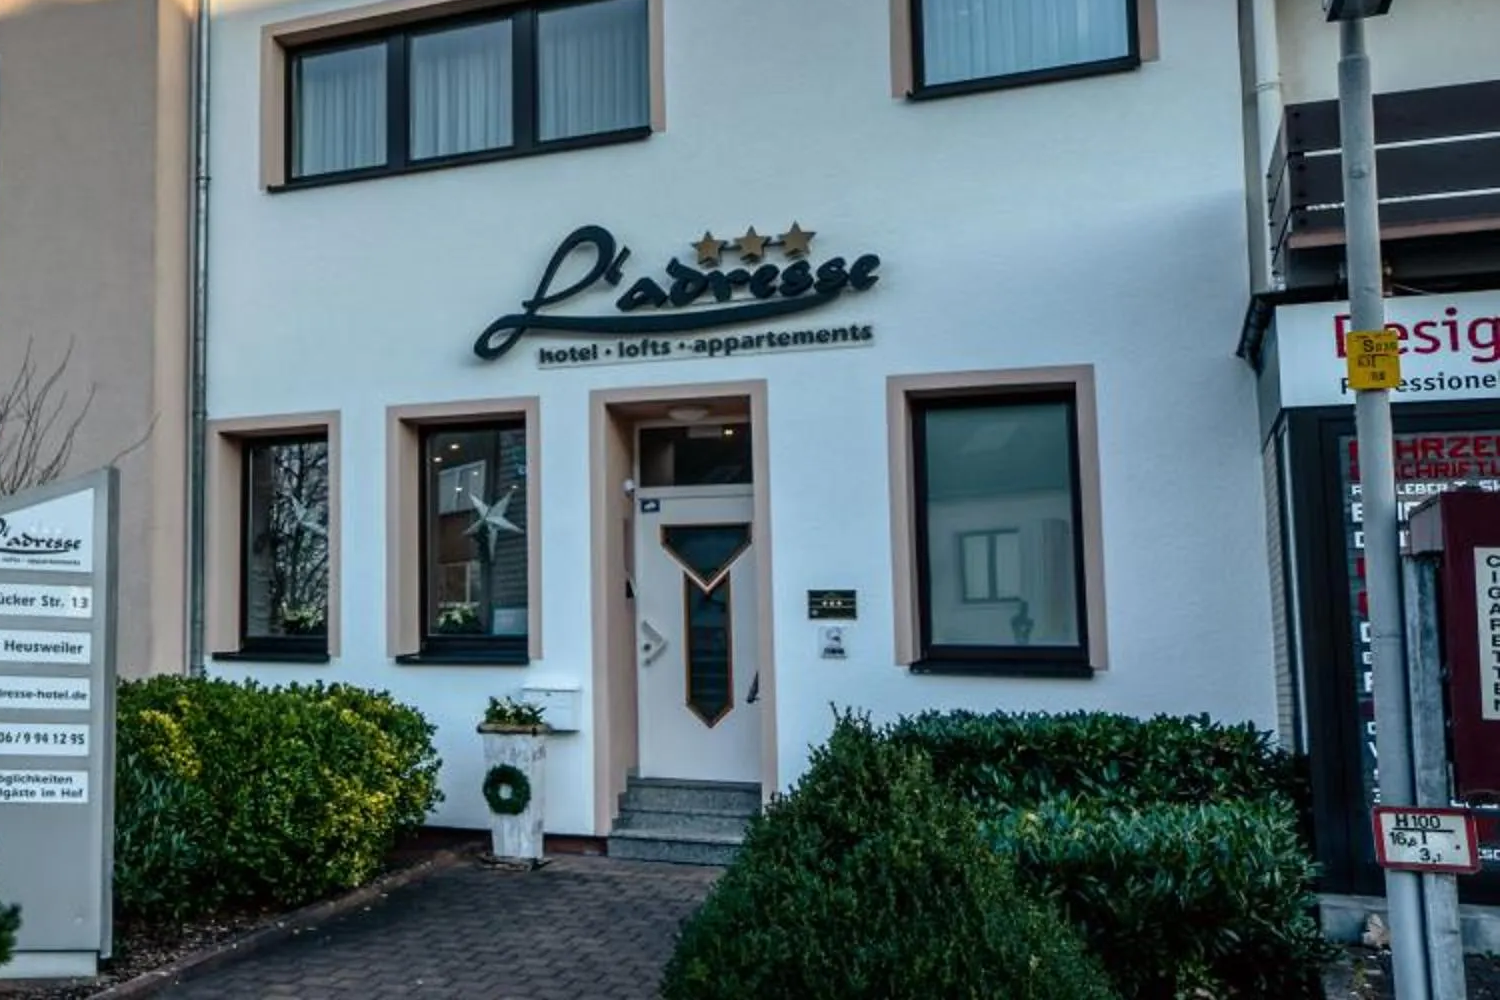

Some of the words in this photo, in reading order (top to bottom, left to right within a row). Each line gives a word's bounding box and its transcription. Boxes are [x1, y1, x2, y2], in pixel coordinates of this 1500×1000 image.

[539, 342, 598, 365] hotel
[618, 339, 672, 359] lofts
[693, 324, 873, 357] appartements
[41, 595, 65, 608] Str.
[71, 596, 90, 609] 13
[4, 640, 84, 655] Heusweiler
[53, 733, 68, 745] 12
[41, 787, 57, 798] im
[61, 788, 84, 798] Hof
